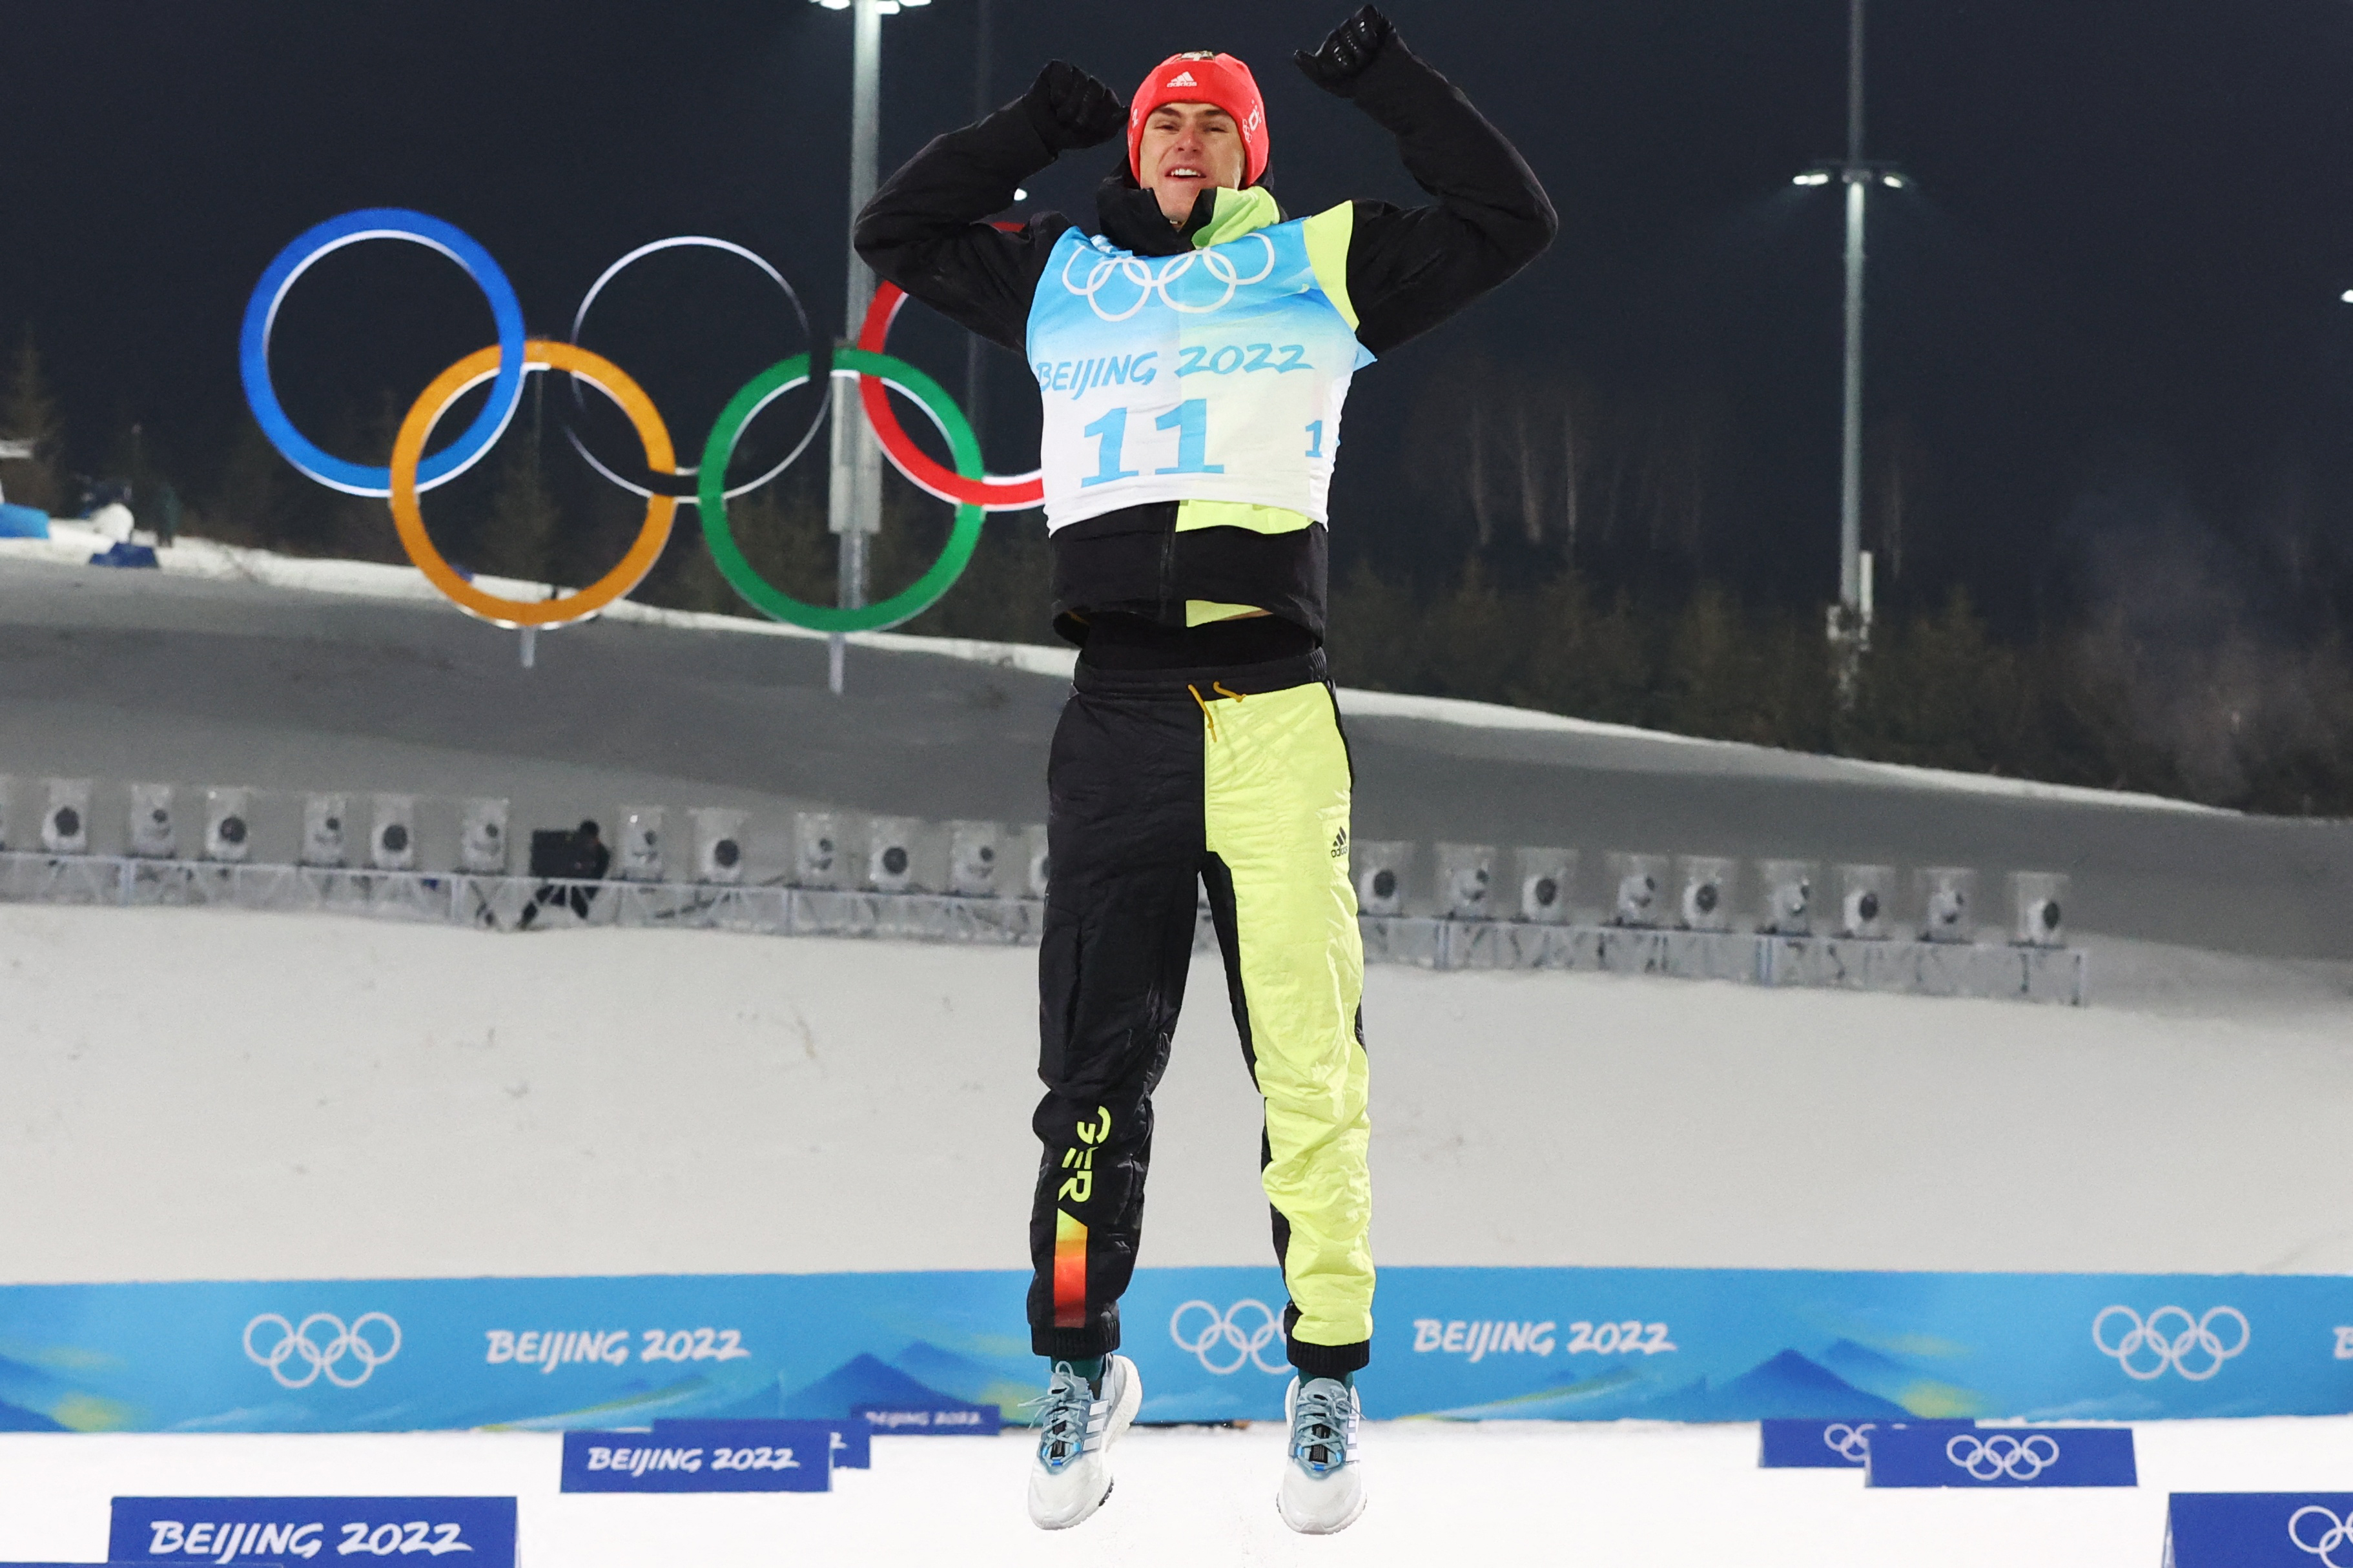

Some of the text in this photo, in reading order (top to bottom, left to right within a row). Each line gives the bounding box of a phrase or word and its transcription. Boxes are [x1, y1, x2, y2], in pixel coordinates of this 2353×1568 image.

[1036, 343, 1313, 400] BEIJING 2022
[1082, 398, 1224, 488] 11
[1058, 1105, 1111, 1203] GER
[486, 1327, 750, 1374] BEIJING 2022
[1412, 1319, 1677, 1363] BEIJING 2022
[588, 1447, 801, 1477] BEIJING 2022
[148, 1520, 473, 1565] BEIJING 2022
